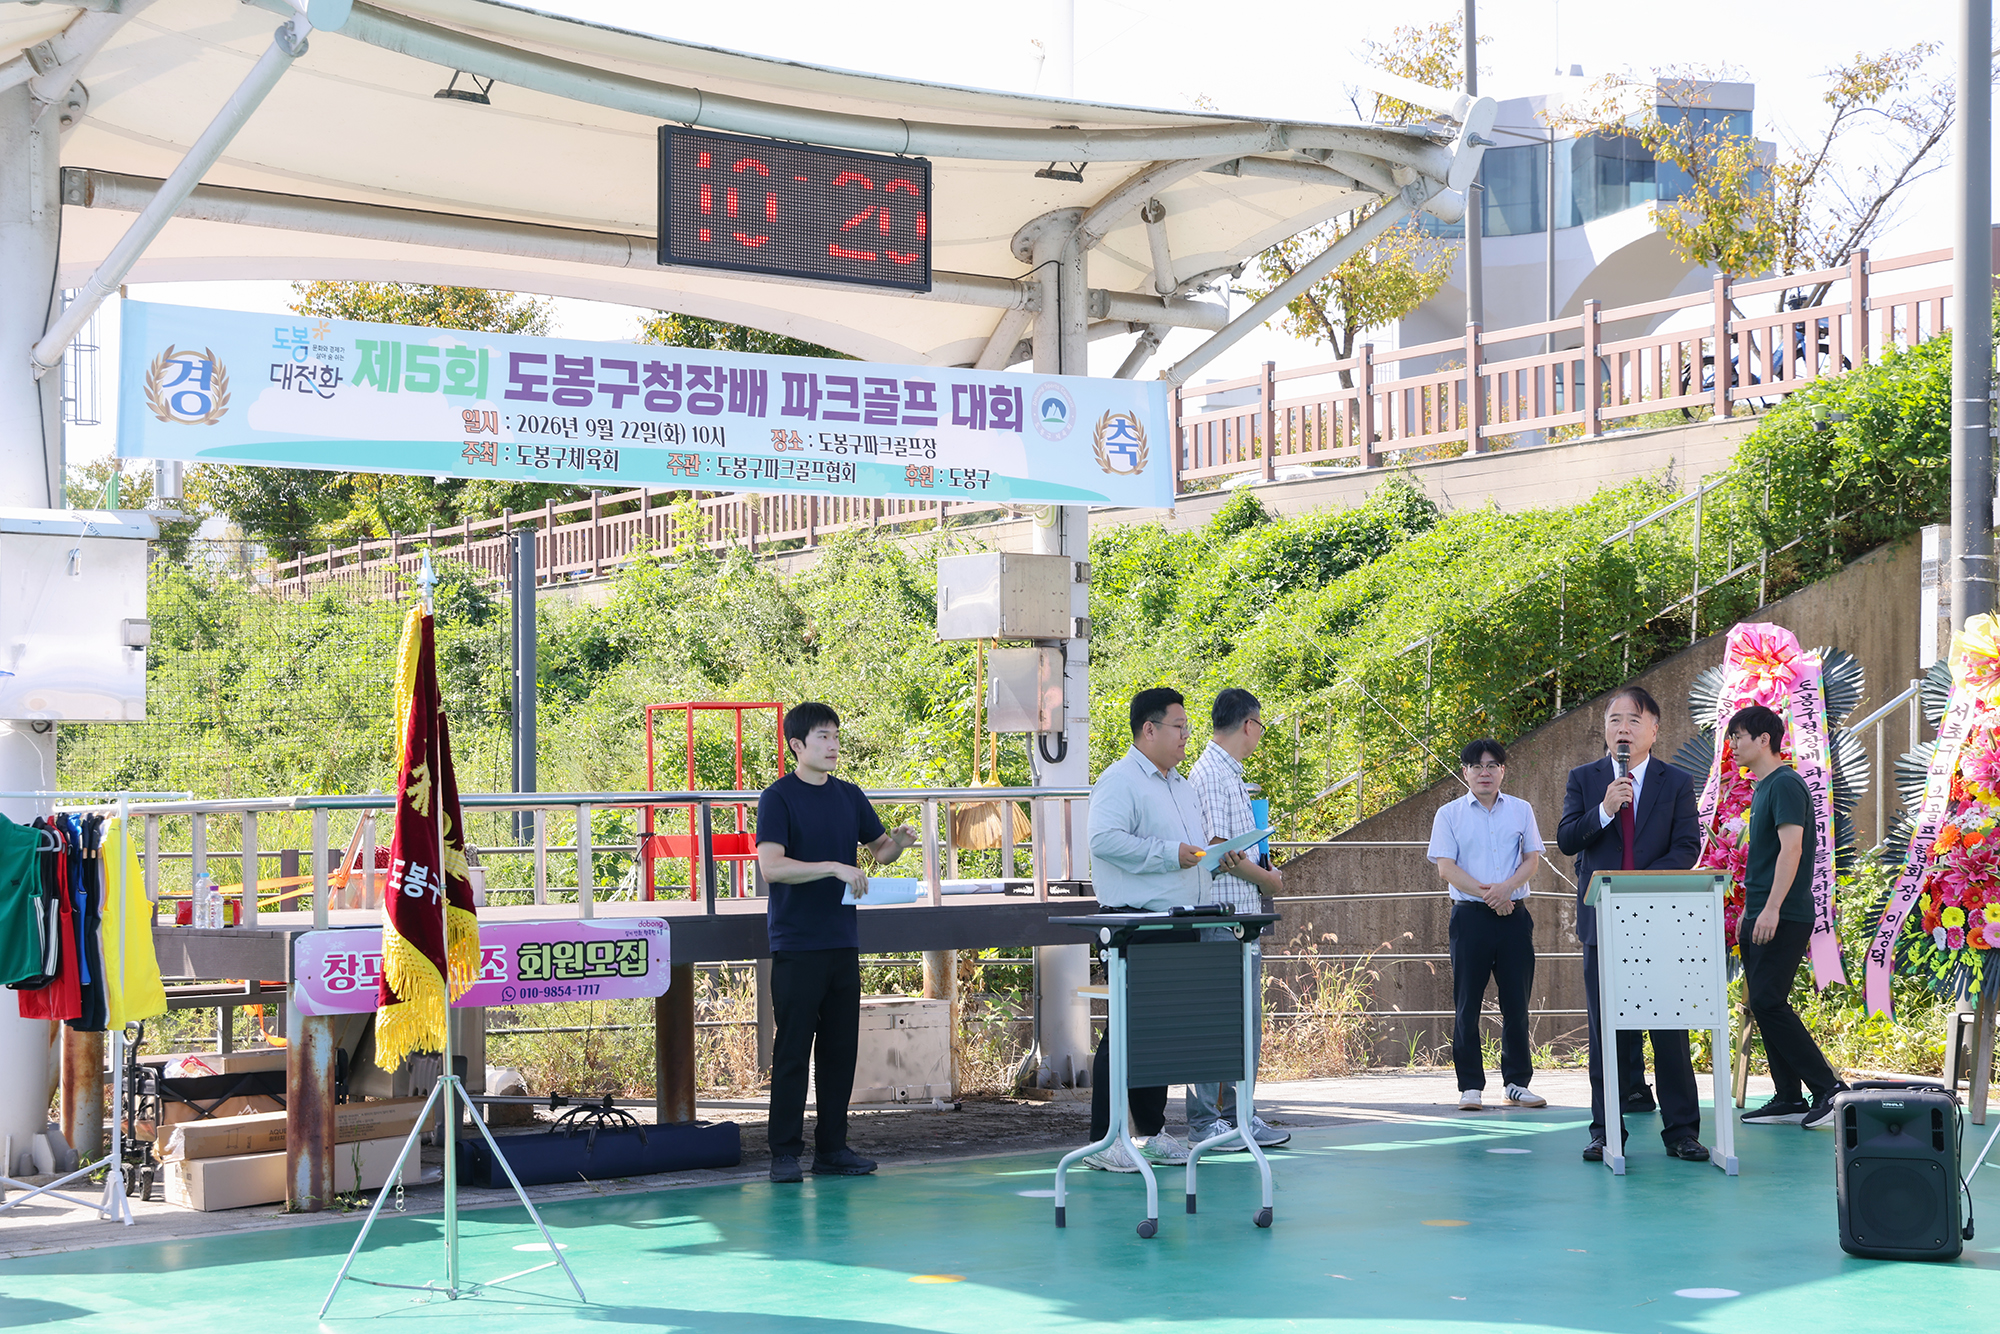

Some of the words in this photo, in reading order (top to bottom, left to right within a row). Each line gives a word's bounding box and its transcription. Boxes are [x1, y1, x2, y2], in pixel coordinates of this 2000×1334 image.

[272, 326, 310, 363] 도봉
[162, 359, 213, 416] 경
[270, 363, 343, 399] 대전환
[351, 339, 489, 400] 제5회
[504, 352, 768, 418] 도봉구청장배
[781, 371, 939, 427] 파크골프
[951, 383, 1024, 432] 대회
[462, 409, 498, 435] 일시
[516, 414, 579, 439] 2026년
[585, 418, 614, 441] 9월
[620, 420, 686, 445] 22일(화)
[692, 425, 726, 448] 10시
[771, 428, 804, 452] 장소
[818, 432, 937, 460] 도봉구파크골프장
[1106, 418, 1138, 467] 축
[462, 441, 498, 466] 주최
[516, 444, 619, 472] 도봉구체육회
[667, 453, 701, 477] 주관
[716, 456, 856, 484] 도봉구파크골프협회
[905, 464, 934, 488] 후원
[949, 467, 991, 490] 도봉구
[388, 858, 442, 905] 도봉구
[638, 920, 664, 928] dobong
[518, 939, 648, 981] 회원모집
[519, 983, 601, 999] 010-9854-1717
